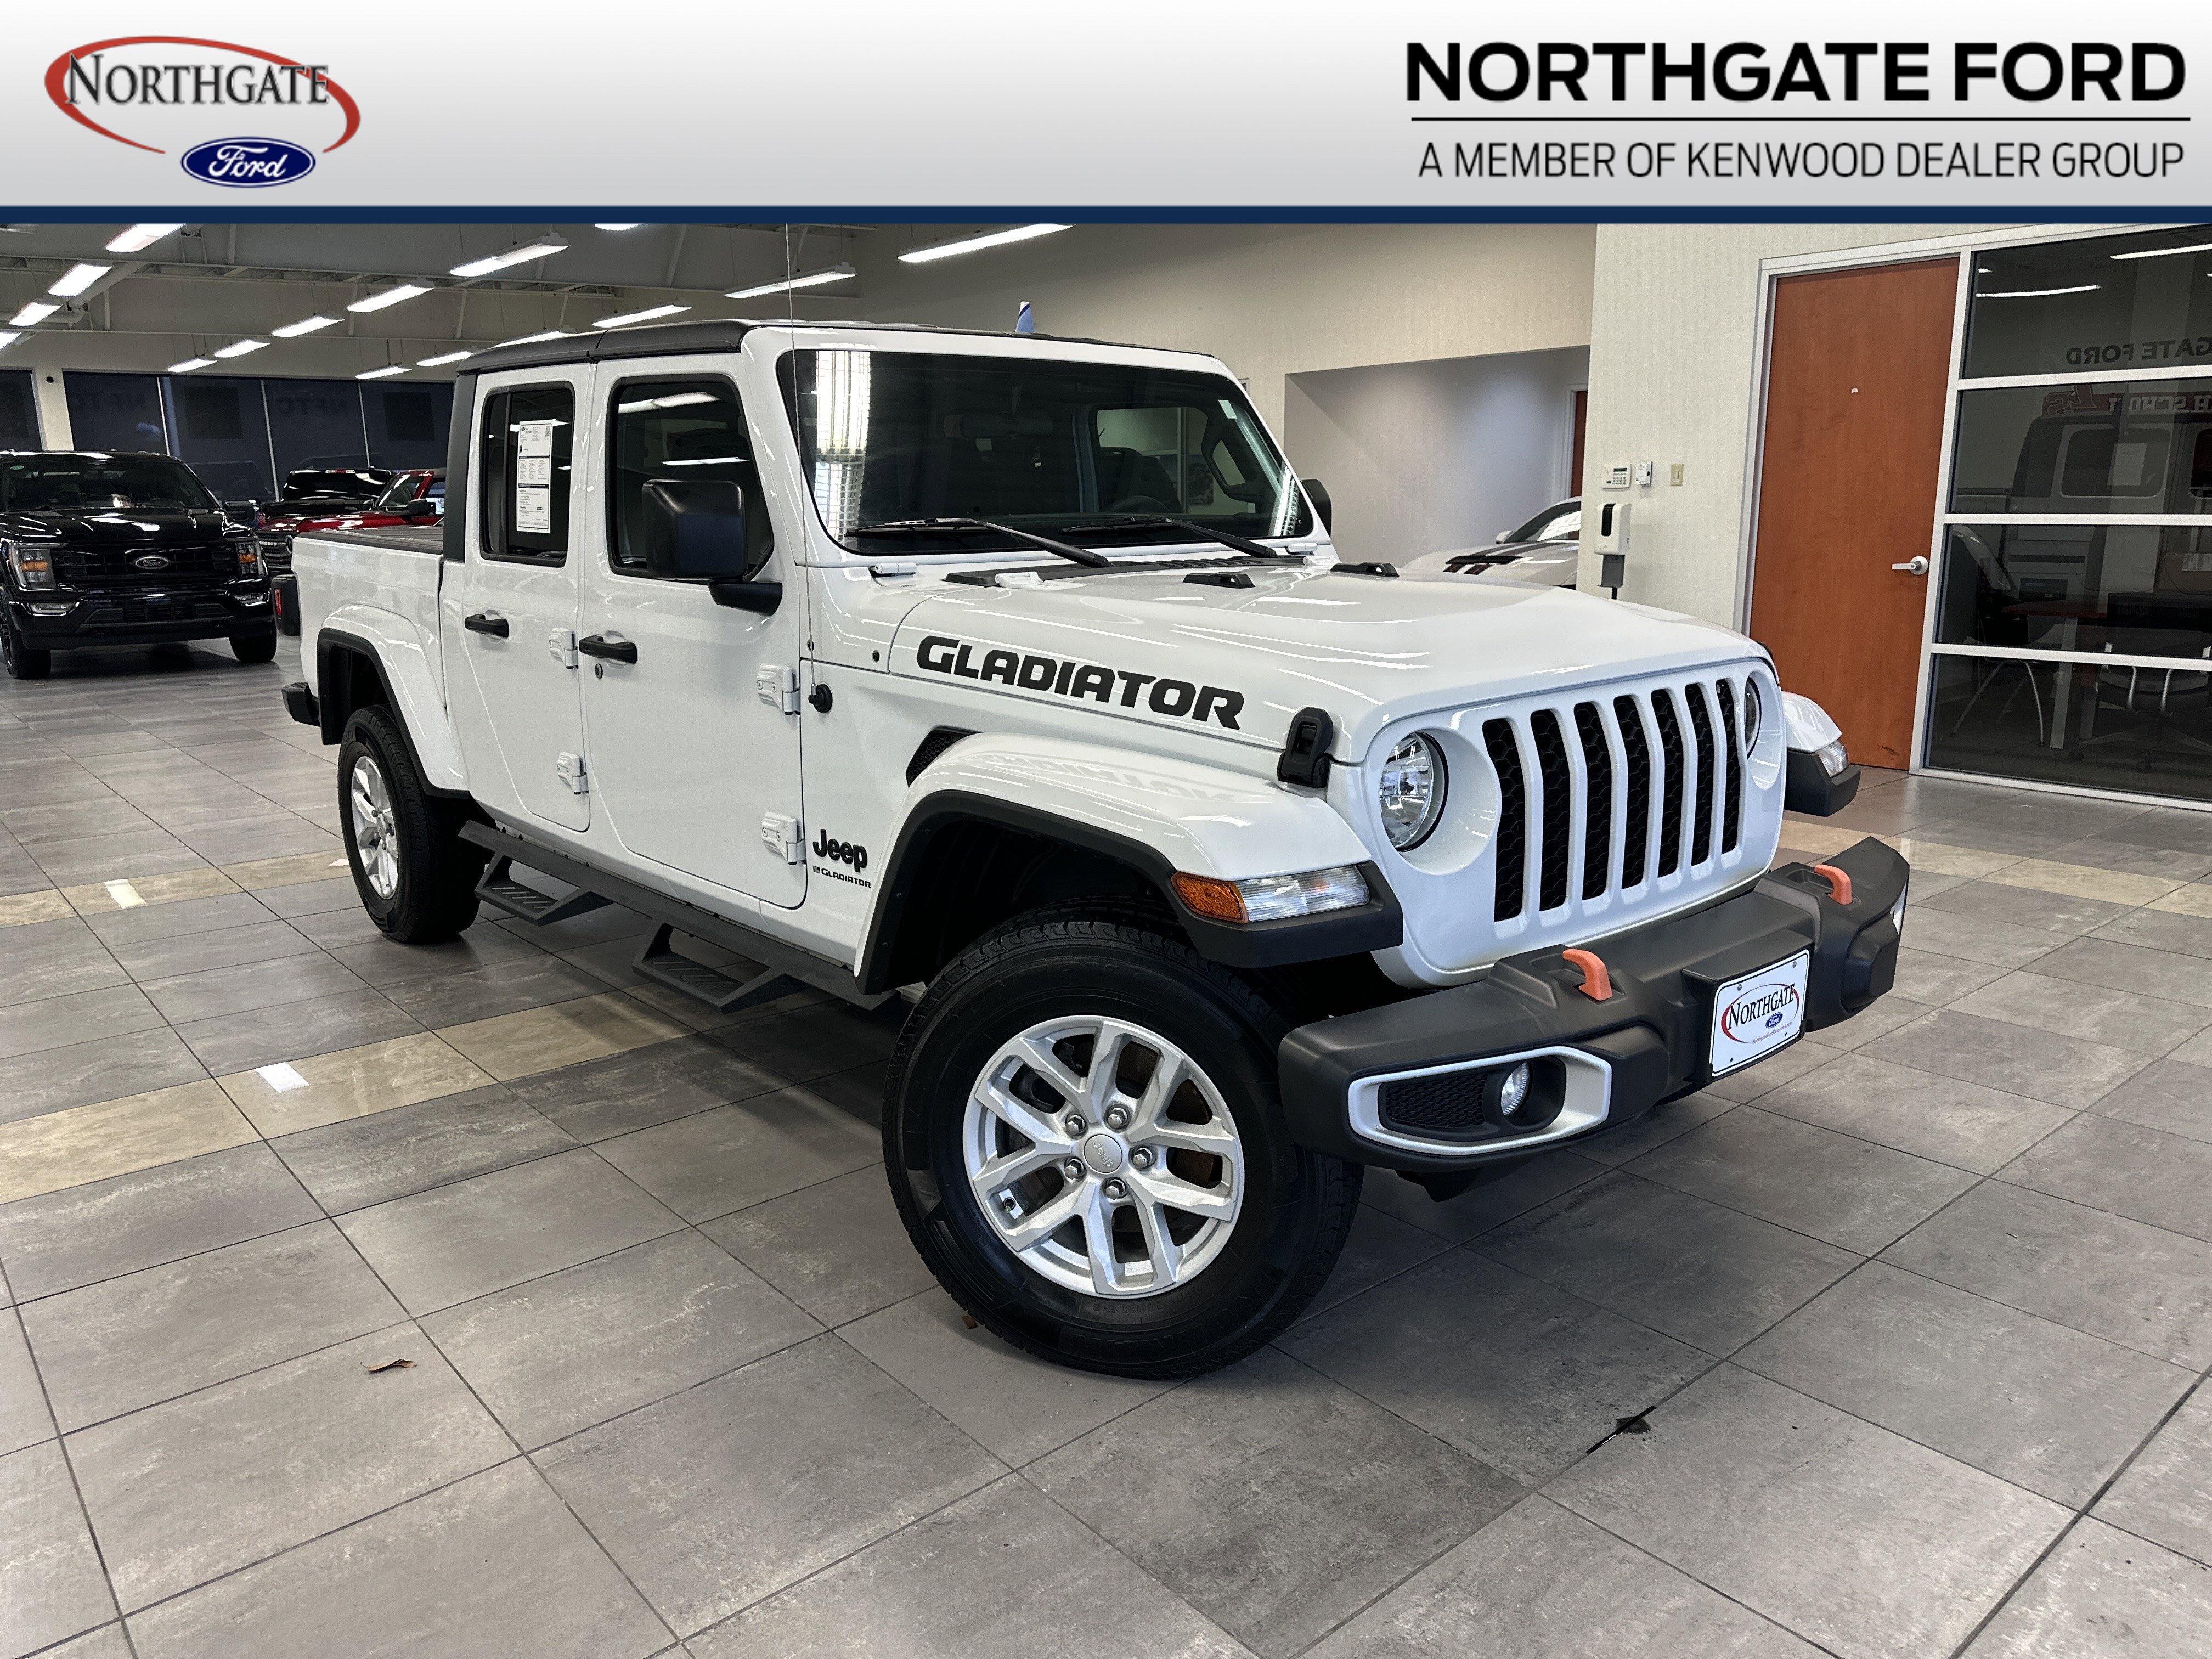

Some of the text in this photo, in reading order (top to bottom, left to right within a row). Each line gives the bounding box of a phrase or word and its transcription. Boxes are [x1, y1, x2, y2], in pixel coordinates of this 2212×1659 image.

[916, 635, 1244, 730] GLADIATOR
[812, 828, 868, 873] Jeep
[821, 868, 871, 889] GLADIATOR
[1727, 983, 1795, 1030] NORTHGATE
[1092, 1140, 1114, 1168] Jeep
